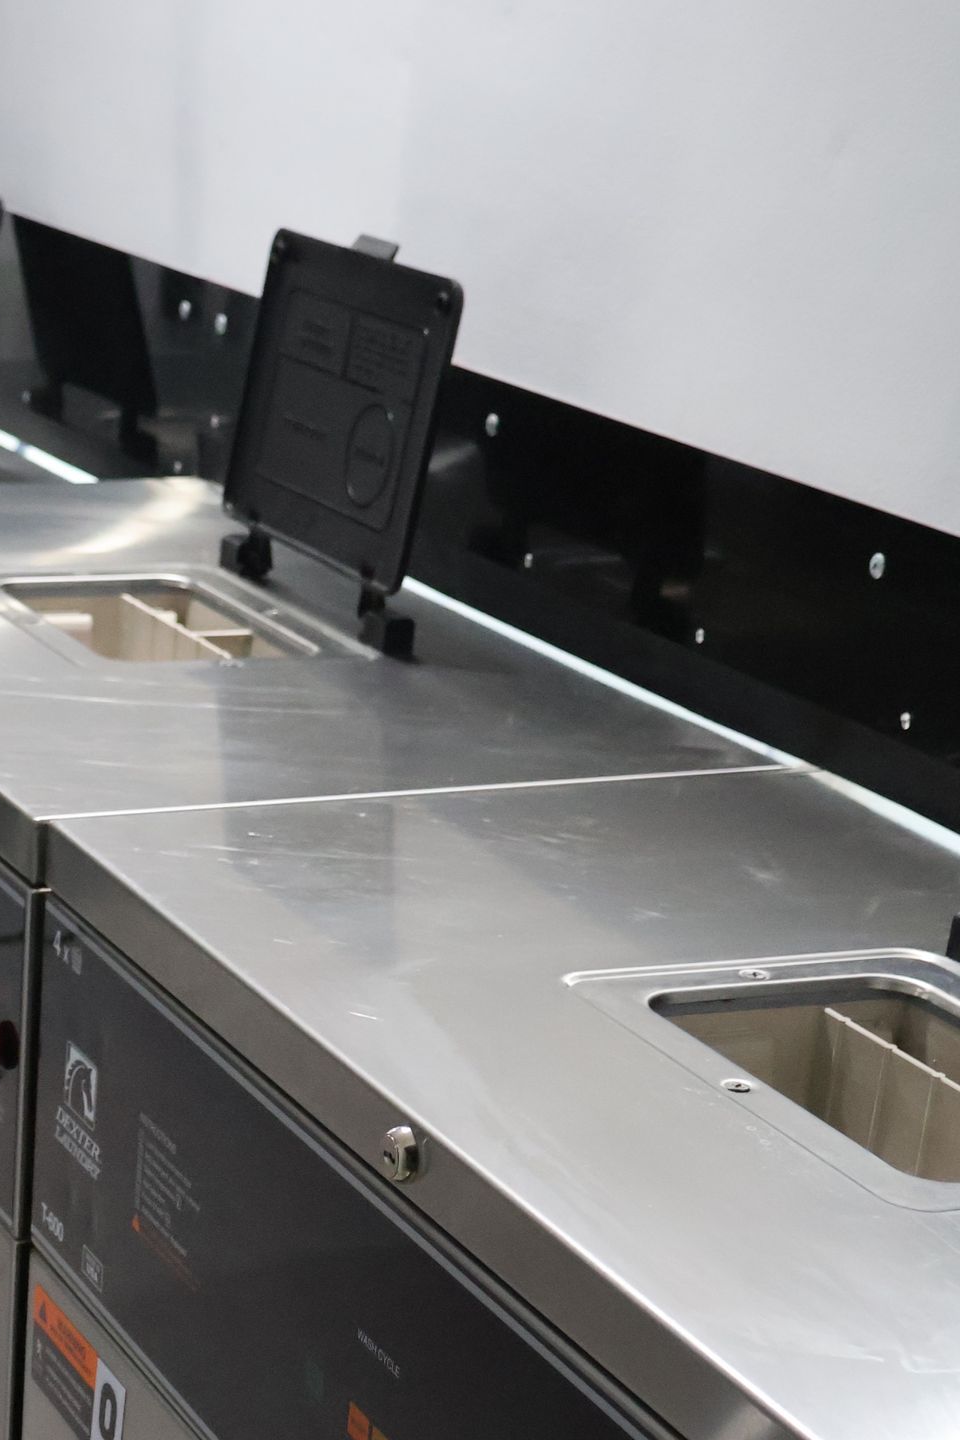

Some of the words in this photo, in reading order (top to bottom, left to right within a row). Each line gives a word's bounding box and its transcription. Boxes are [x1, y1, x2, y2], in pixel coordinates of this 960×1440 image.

[56, 1106, 100, 1162] DEXTER
[357, 1327, 377, 1357] WASH
[377, 1347, 401, 1379] CYCLE
